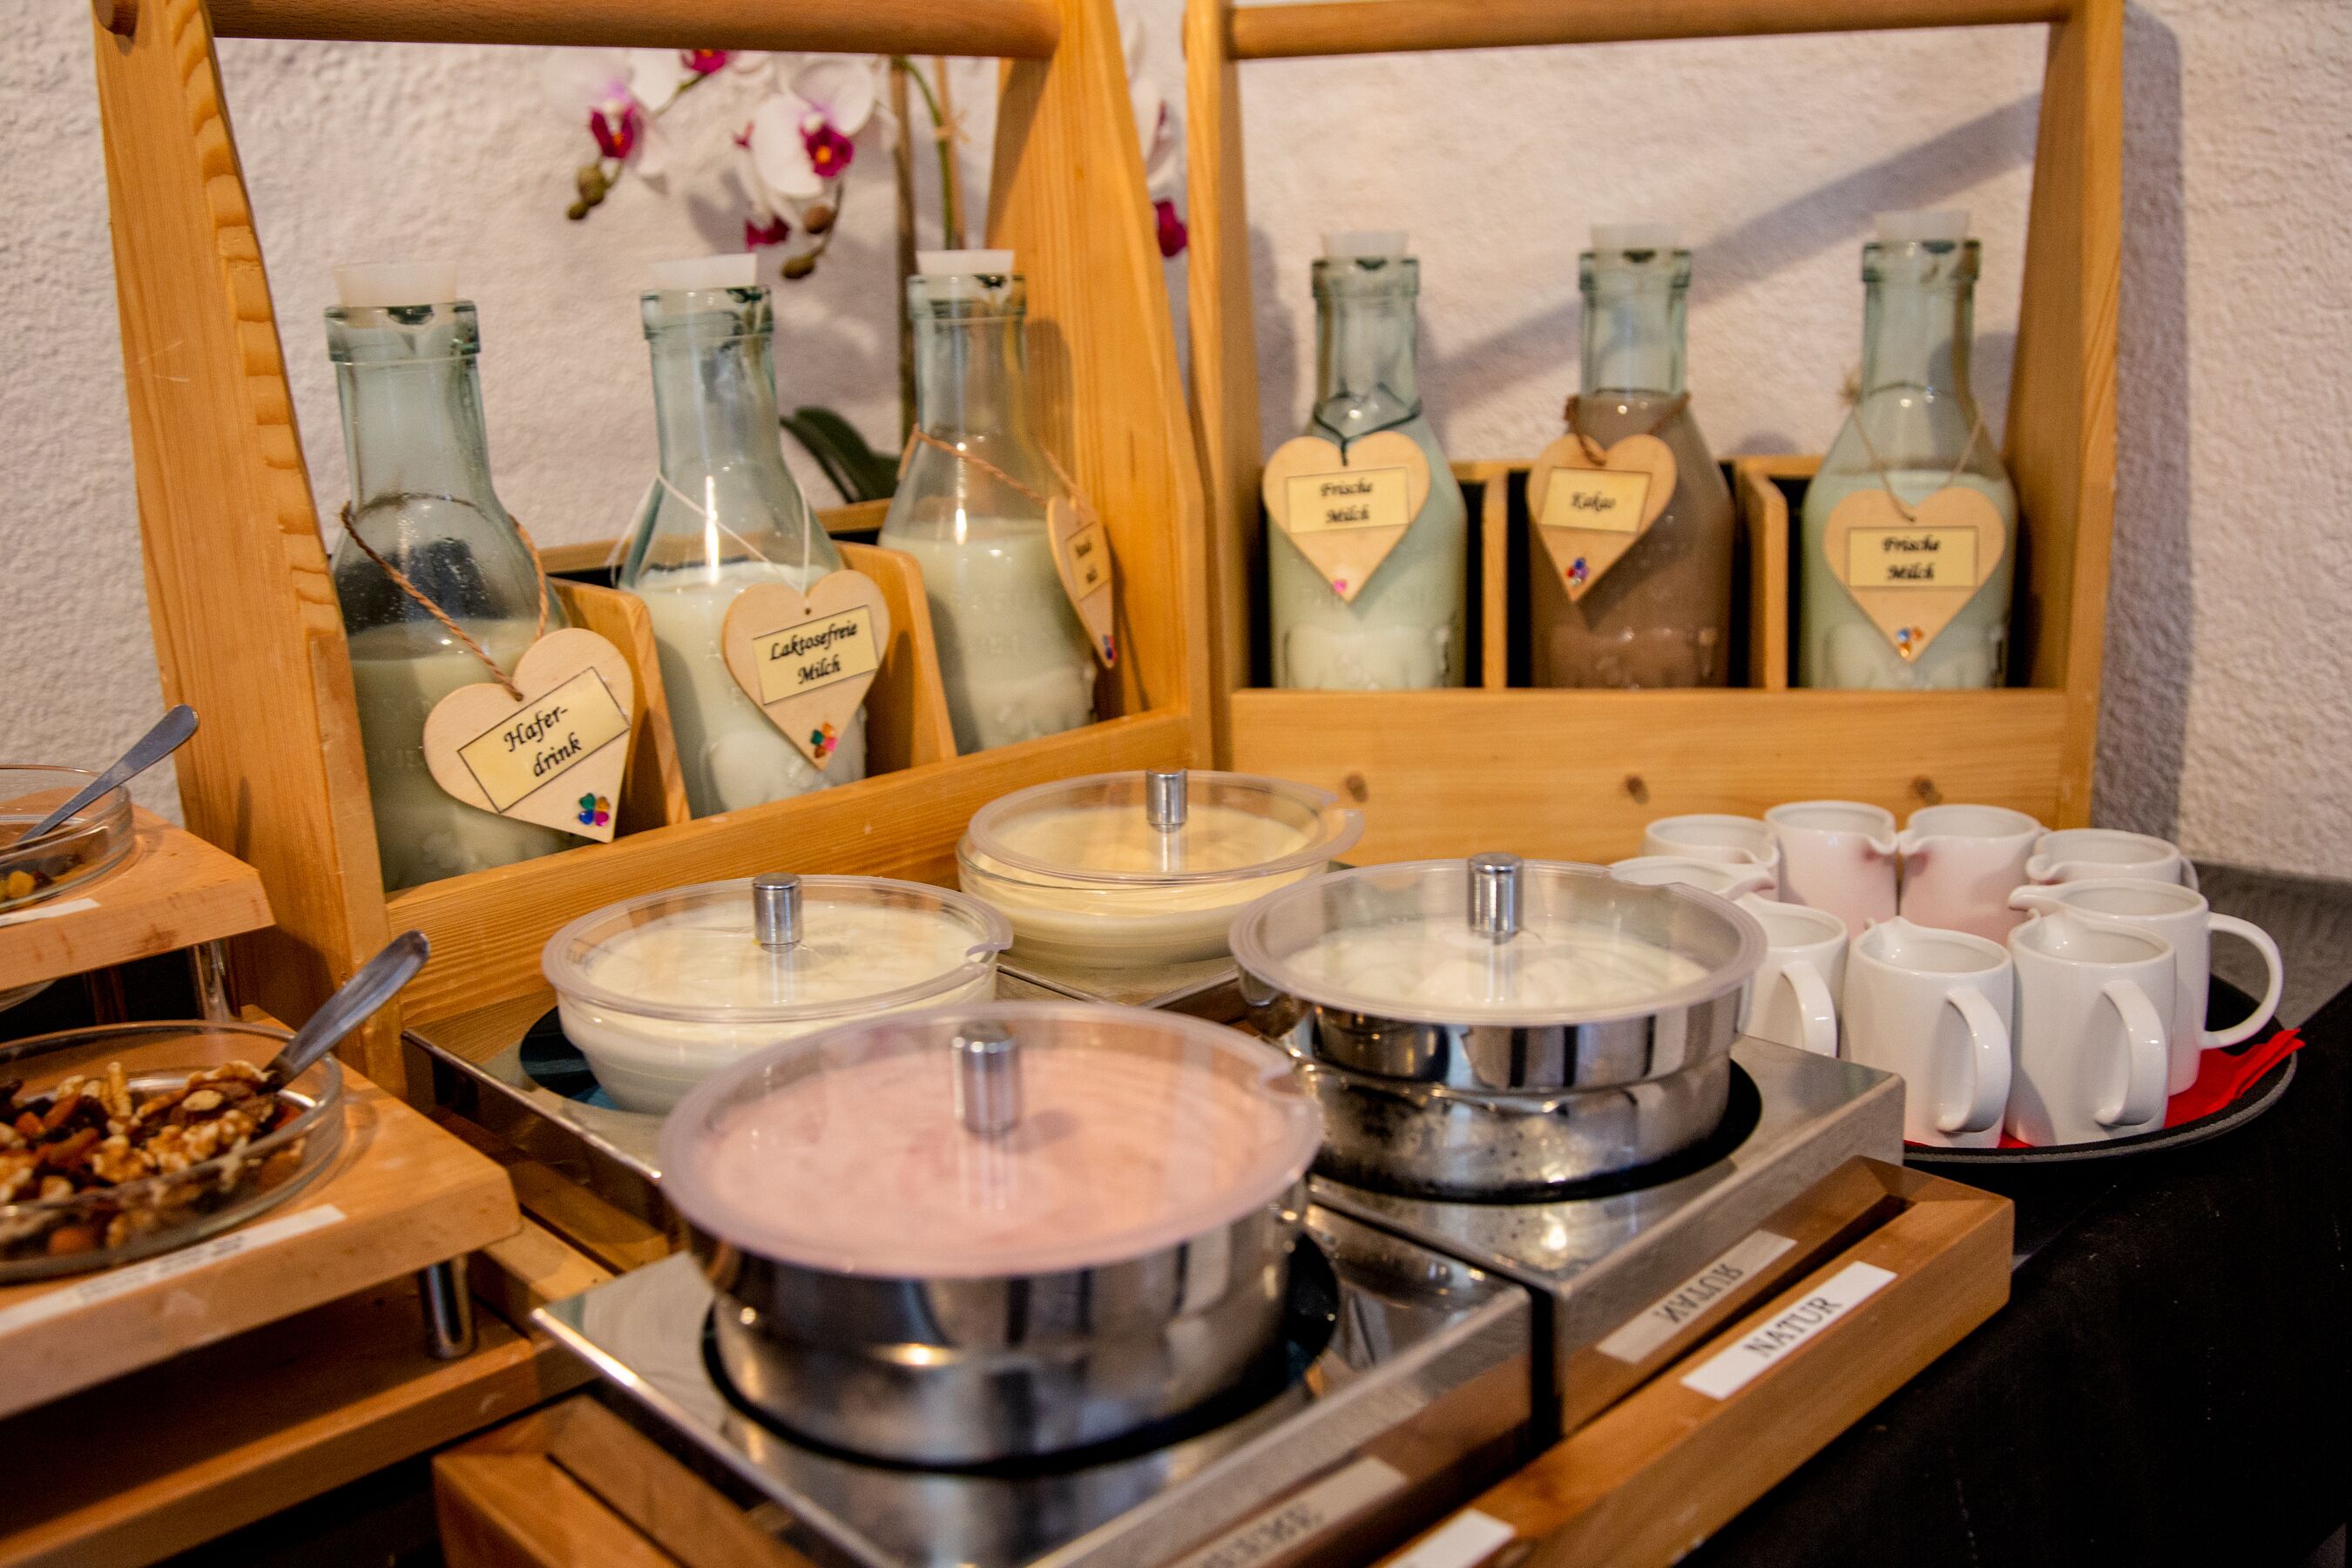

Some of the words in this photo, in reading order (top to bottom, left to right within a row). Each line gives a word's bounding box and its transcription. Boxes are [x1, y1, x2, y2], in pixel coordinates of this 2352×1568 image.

[770, 620, 857, 660] Laktosefreie
[798, 654, 841, 684] Milch
[504, 706, 569, 753] Hafer-
[533, 732, 583, 778] drink
[1744, 1295, 1843, 1358] NATUR
